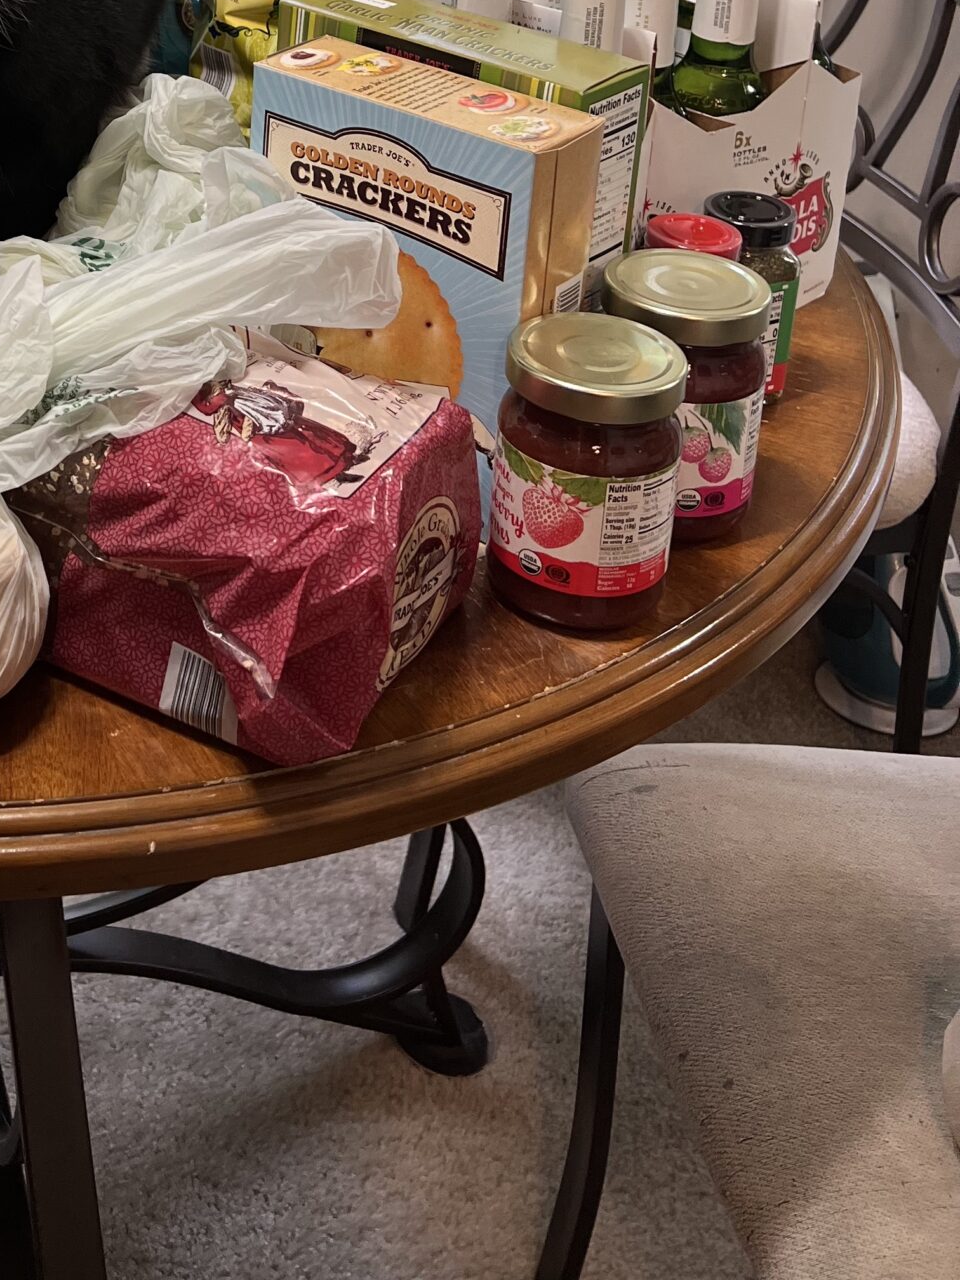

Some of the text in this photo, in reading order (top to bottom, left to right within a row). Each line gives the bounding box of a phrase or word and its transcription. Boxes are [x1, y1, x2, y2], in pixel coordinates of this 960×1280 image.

[414, 12, 497, 39] ORGANIC
[325, 0, 393, 23] GARLIC
[394, 18, 454, 43] NAAN
[455, 36, 557, 72] CRACKERS
[590, 88, 641, 117] Nutrition Facts
[349, 140, 384, 157] TRADER
[621, 131, 636, 149] 130
[734, 130, 752, 149] 6x
[732, 145, 768, 159] BOTTLES
[763, 158, 787, 184] ANNO
[289, 141, 477, 221] GOLDEN ROUNDS
[289, 160, 473, 246] CRACKERS
[608, 484, 641, 494] Nutrition
[681, 493, 697, 501] USDA
[607, 495, 629, 503] Facts
[624, 535, 634, 544] 25
[523, 553, 538, 564] USDA
